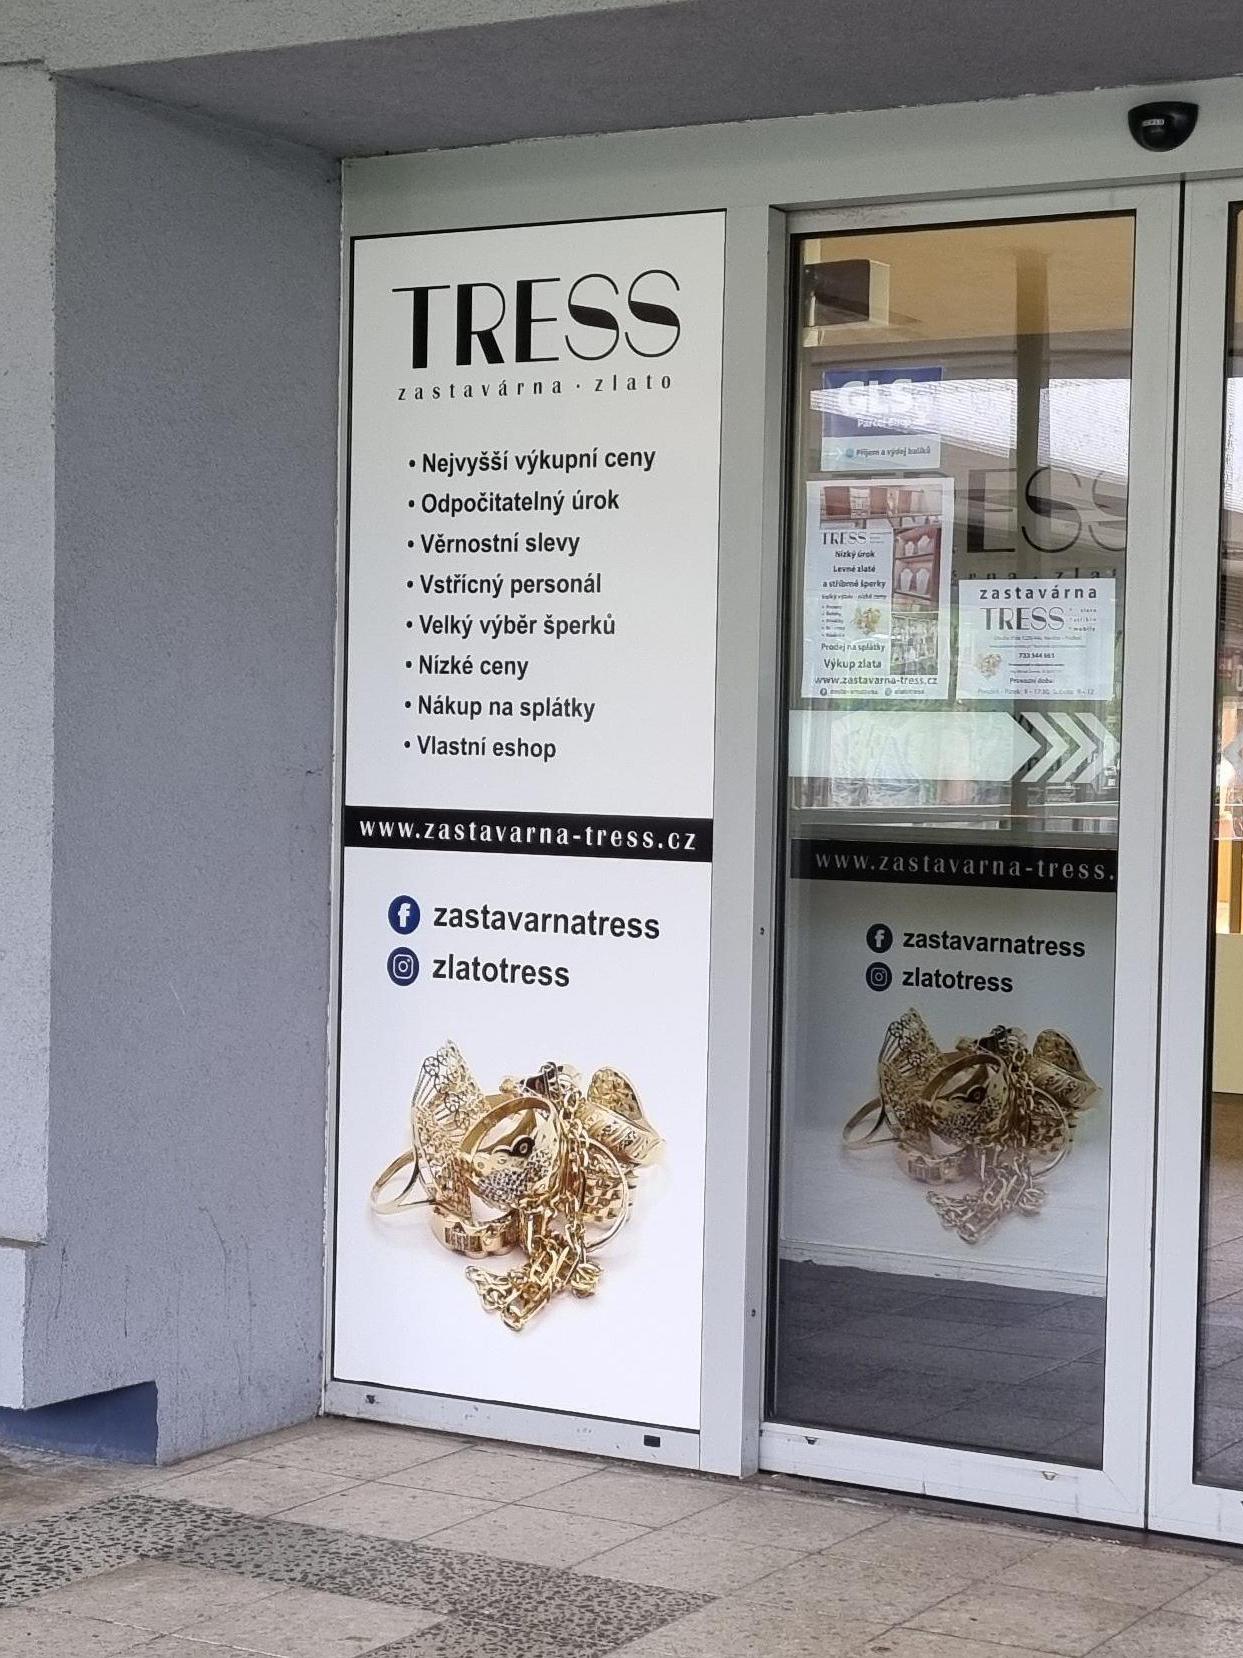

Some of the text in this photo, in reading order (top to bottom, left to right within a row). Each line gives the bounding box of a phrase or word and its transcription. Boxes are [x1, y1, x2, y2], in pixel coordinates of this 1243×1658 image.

[392, 269, 681, 370] TRESS
[397, 373, 672, 402] zastavárna zlato
[421, 446, 656, 478] Nejvyšší výkupní ceny
[421, 489, 620, 518] Odpočitatelný úrok
[954, 465, 1128, 554] ESS
[420, 531, 581, 558] Věrnostní slevy
[820, 531, 867, 546] TRESS
[420, 572, 602, 599] Vstřícný personál
[979, 584, 1098, 601] zastavárna
[419, 612, 617, 640] Velký výběr šperků
[979, 606, 1065, 631] TRESS
[418, 654, 529, 682] Nízké ceny
[823, 658, 883, 671] Výkup zlata
[814, 675, 939, 686] www.zastavarna-tress.cz
[417, 695, 596, 723] Nákup na splátky
[417, 735, 557, 763] Vlastní eshop
[358, 819, 697, 852] www.zastavarna-tress.cz
[433, 903, 661, 941] zastavarnatress
[902, 930, 1086, 958] zastavarnatress
[431, 953, 571, 988] zlatotress
[901, 966, 1014, 993] zlatotress
